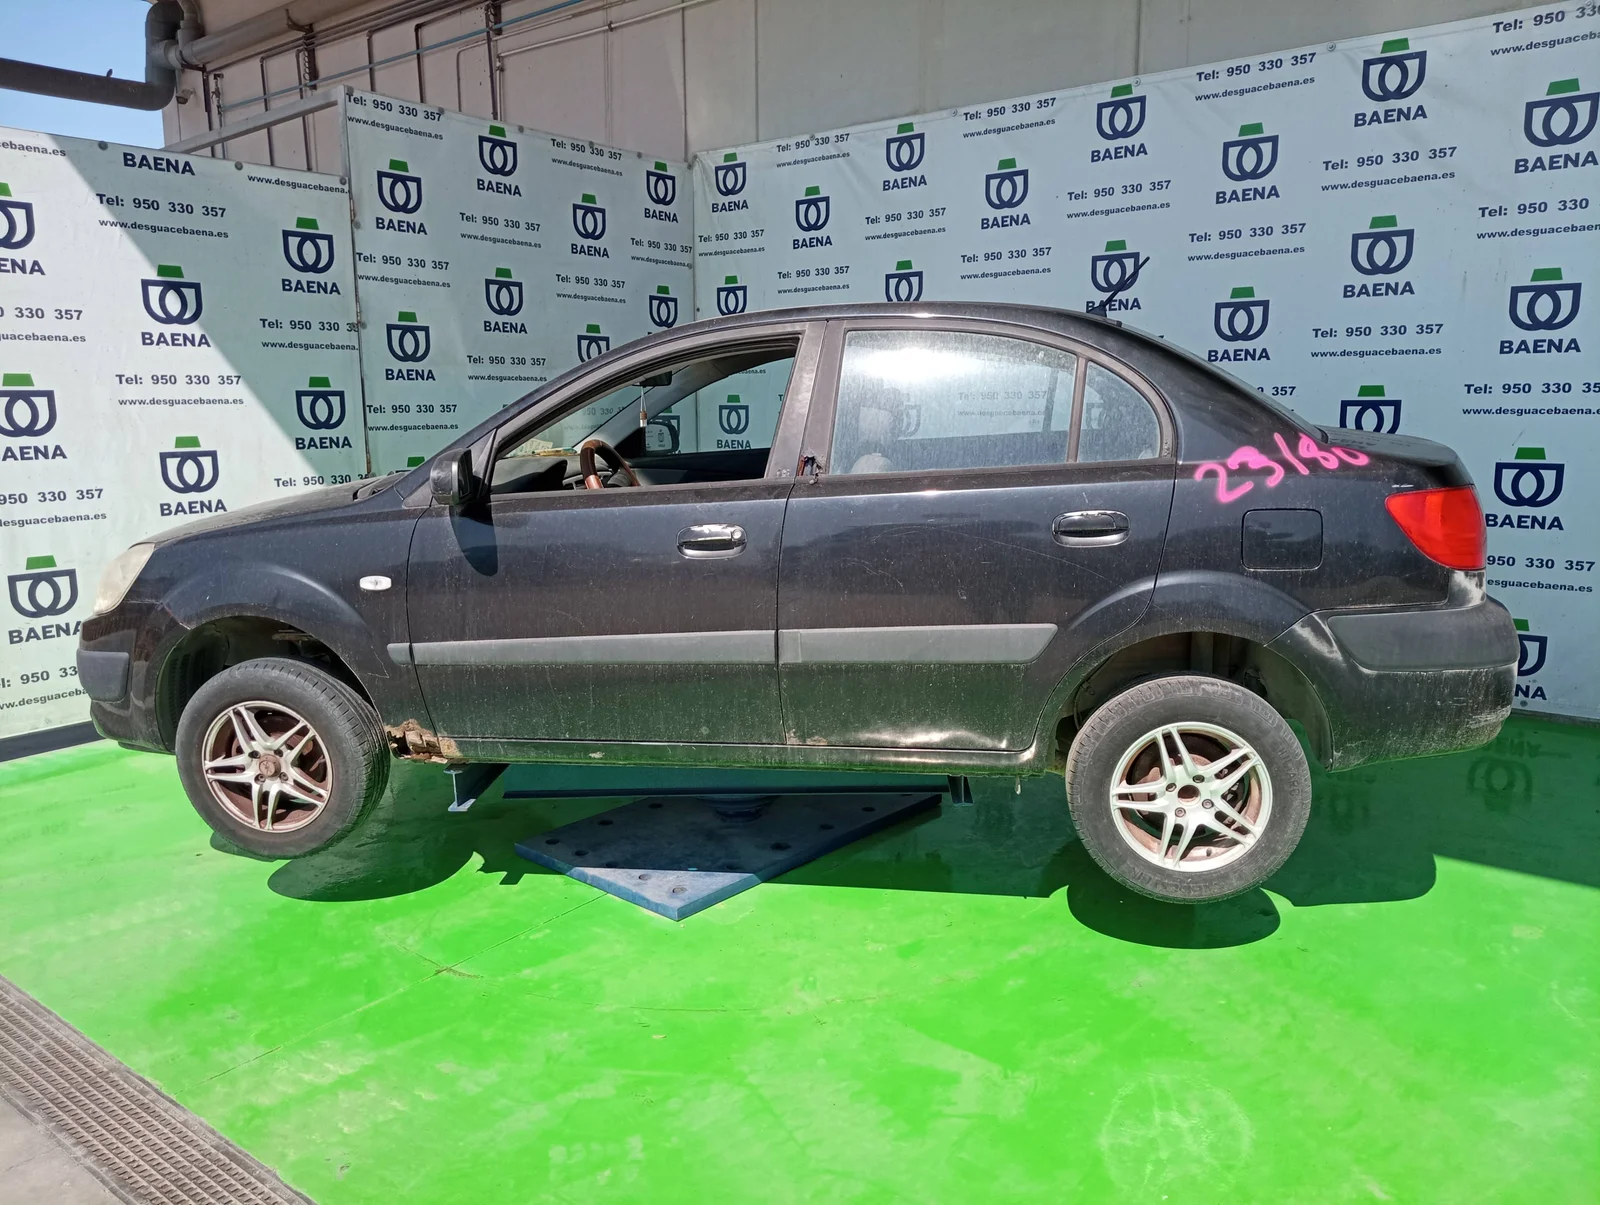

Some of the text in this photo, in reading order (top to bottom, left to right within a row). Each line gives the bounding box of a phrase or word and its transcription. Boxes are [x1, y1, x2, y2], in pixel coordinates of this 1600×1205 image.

[1493, 11, 1565, 33] Tel: 950
[1196, 52, 1316, 81] Tel: 950 330 357
[1195, 76, 1315, 101] www.desguacebaena.es
[346, 94, 441, 122] Tel: 950 330 357
[964, 98, 1056, 120] Tel: 950 330 357
[1354, 105, 1427, 127] BAENA
[348, 115, 443, 140] www.desguacebaena.es
[963, 118, 1055, 138] www.desguacebaena.es
[551, 138, 622, 160] Tel: 950 330 357
[776, 133, 849, 152] Tel: 950 330 357
[777, 152, 850, 167] www.desguacebaena.es
[1091, 143, 1147, 162] BAENA
[1323, 147, 1457, 170] Tel: 950 330 357
[123, 150, 197, 175] BAENA
[552, 157, 622, 176] www.desguacebaena.es
[1514, 151, 1598, 174] BAENA
[477, 179, 521, 197] BAENA
[883, 175, 927, 191] BAENA
[1321, 172, 1455, 191] www.desguacebaena.es
[1068, 180, 1171, 200] Tel: 950 330 357
[1216, 185, 1280, 204] BAENA
[96, 193, 226, 217] Tel: 950 330 357
[712, 200, 748, 212] BAENA
[1067, 203, 1170, 218] www.desguacebaena.es
[1479, 198, 1589, 217] Tel: 950 330
[460, 212, 540, 231] Tel: 950 330 357
[645, 208, 678, 223] BAENA
[865, 208, 946, 224] Tel: 950 330 357
[981, 214, 1030, 229] BAENA
[99, 220, 229, 238] www.desguacebaena.es
[376, 217, 427, 235] BAENA
[865, 228, 946, 240] www.desguacebaena.es
[1189, 223, 1306, 242] Tel: 950 330 357
[461, 233, 541, 248] www.desguacebaena.es
[715, 233, 729, 241] 950
[734, 231, 747, 240] 330
[751, 229, 764, 238] 357
[793, 236, 832, 249] BAENA
[571, 243, 609, 258] BAENA
[631, 238, 692, 253] Tel: 950 330 357
[698, 247, 765, 256] www.desguacebaena.es
[356, 253, 449, 270] Tel: 950 330 357
[961, 247, 1051, 263] Tel: 950 330 357
[1188, 247, 1304, 261] www.desguacebaena.es
[357, 274, 450, 288] www.desguacebaena.es
[961, 268, 1051, 279] www.desguacebaena.es
[282, 279, 341, 295] BAENA
[1343, 281, 1415, 298] BAENA
[15, 307, 44, 319] 330
[55, 309, 82, 320] 357
[260, 319, 282, 329] Tel:
[290, 320, 311, 330] 950
[319, 322, 339, 331] 330
[484, 321, 527, 334] BAENA
[1313, 324, 1443, 338] Tel: 950 330 357
[141, 332, 210, 347] BAENA
[1500, 338, 1581, 354] BAENA
[467, 355, 546, 366] Tel: 950 330 357
[1208, 348, 1270, 362] BAENA
[1311, 348, 1441, 358] www.desguacebaena.es
[115, 375, 241, 385] Tel: 950 330 357
[385, 369, 435, 381] BAENA
[468, 374, 547, 382] www.desguacebaena.es
[1272, 386, 1296, 396] 357
[1464, 384, 1492, 394] Tel:
[1502, 383, 1531, 393] 950
[1542, 383, 1571, 393] 330
[118, 397, 243, 407] www.desguacebaena.es
[366, 404, 457, 414] Tel: 950 330 357
[368, 423, 458, 432] www.desguacebaena.es
[295, 436, 352, 449] BAENA
[716, 440, 752, 449] BAENA
[274, 478, 296, 487] Tel:
[303, 475, 324, 485] 950
[331, 475, 351, 484] 330
[0, 489, 103, 505] 950 330 357
[160, 499, 227, 516] BAENA
[1485, 514, 1564, 531] BAENA
[1487, 555, 1595, 571] 950 330 357
[20, 671, 49, 684] 950
